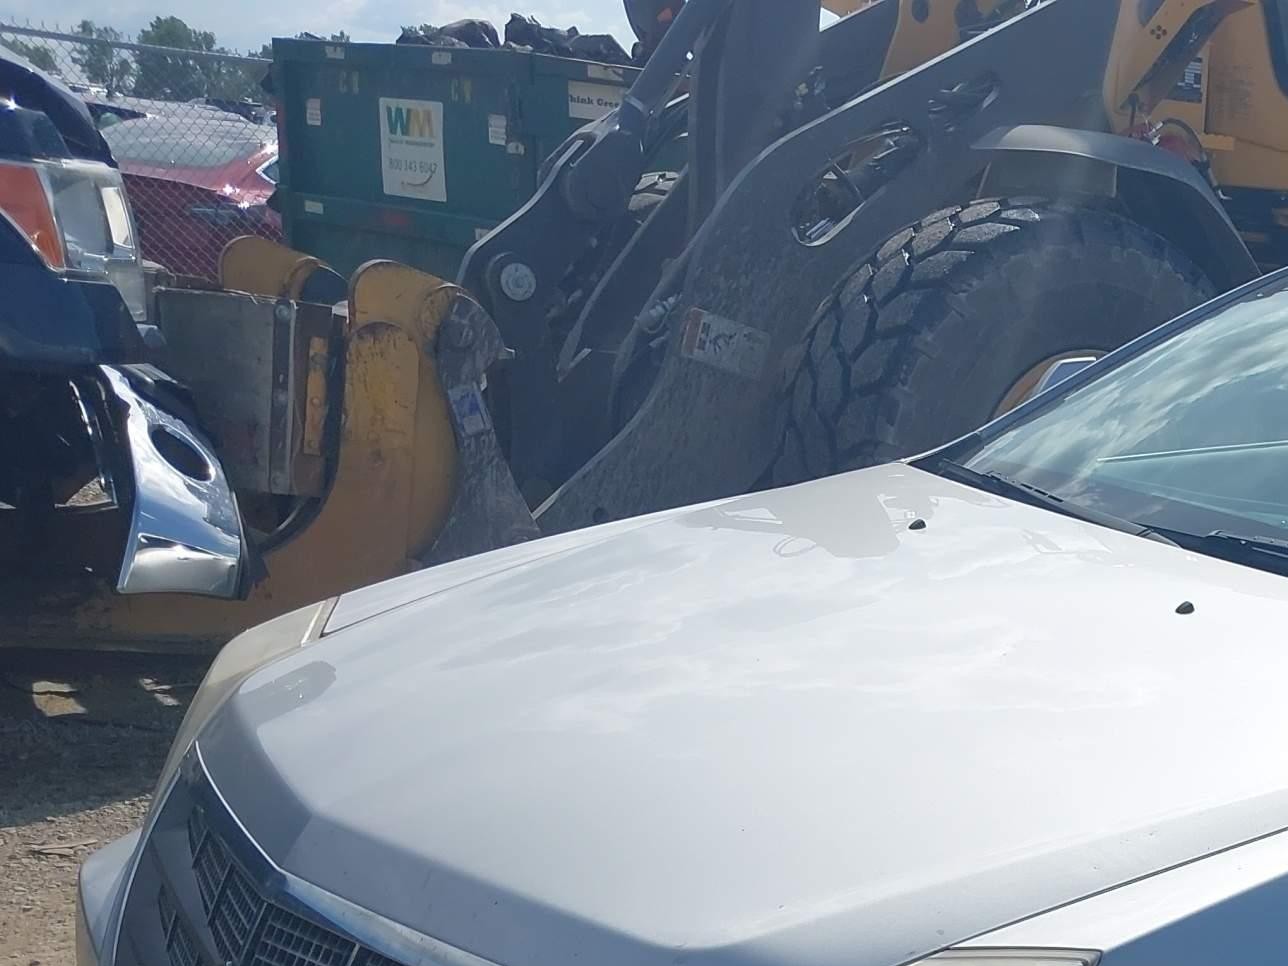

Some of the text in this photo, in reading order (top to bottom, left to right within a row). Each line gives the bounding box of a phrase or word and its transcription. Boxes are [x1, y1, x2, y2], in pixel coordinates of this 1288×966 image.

[569, 95, 620, 108] hink Gree
[386, 105, 435, 137] WM
